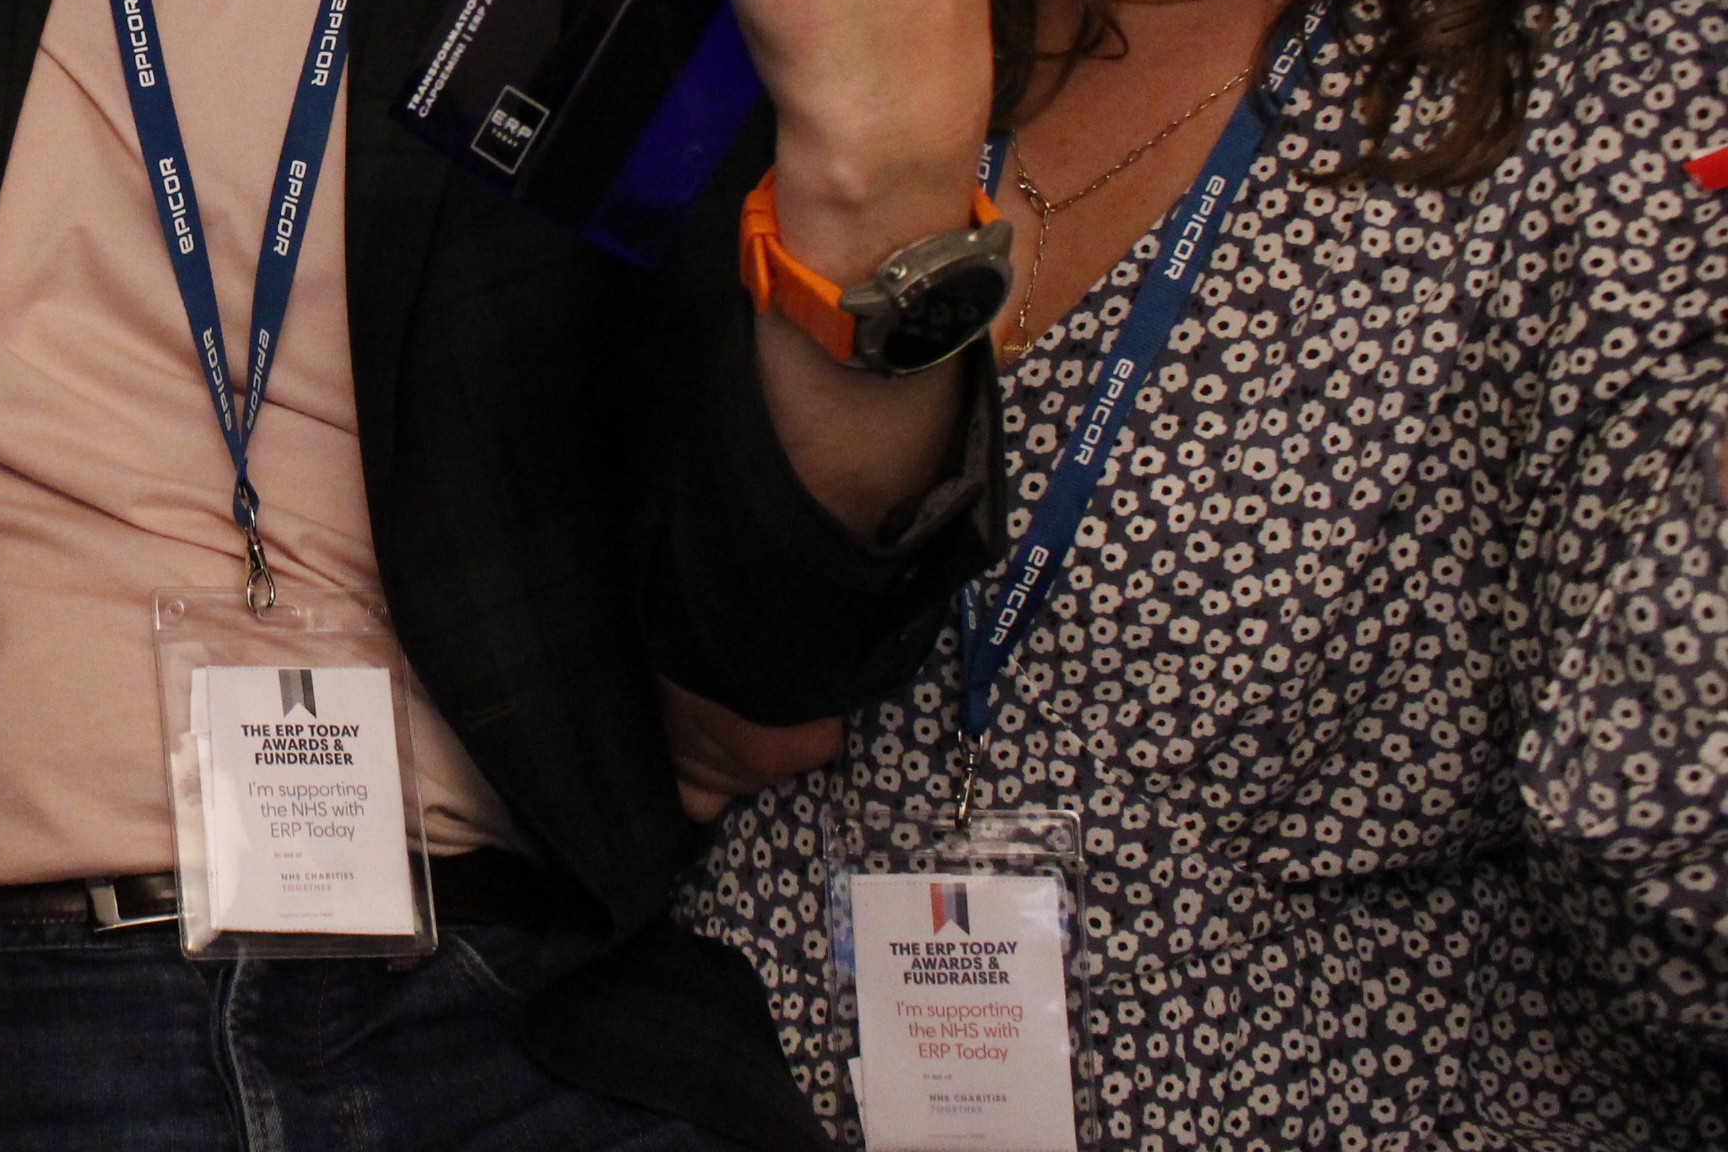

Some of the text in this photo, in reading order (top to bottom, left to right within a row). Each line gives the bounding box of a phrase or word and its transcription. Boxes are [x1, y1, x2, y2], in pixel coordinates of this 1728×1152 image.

[418, 42, 467, 118] CAPGEMINI
[468, 6, 486, 32] ERP
[491, 109, 534, 139] ERP
[241, 724, 360, 738] THE ERP TODAY
[262, 739, 344, 751] AWARDS &
[254, 752, 354, 766] FUNDRAISER
[248, 781, 368, 801] I'm supporting
[260, 801, 365, 817] the NHS with
[270, 822, 356, 841] ERP Today
[281, 872, 354, 881] NHS CHARITIES
[889, 941, 1018, 956] THE ERP TODAY
[910, 957, 1000, 970] AWARDS &
[903, 971, 1010, 985] FUNDRAISER
[896, 1001, 1023, 1022] I'm supporting
[908, 1022, 1020, 1038] the NHS with
[919, 1044, 1009, 1064] ERP Today
[929, 1094, 1007, 1103] NHS CHARITIES
